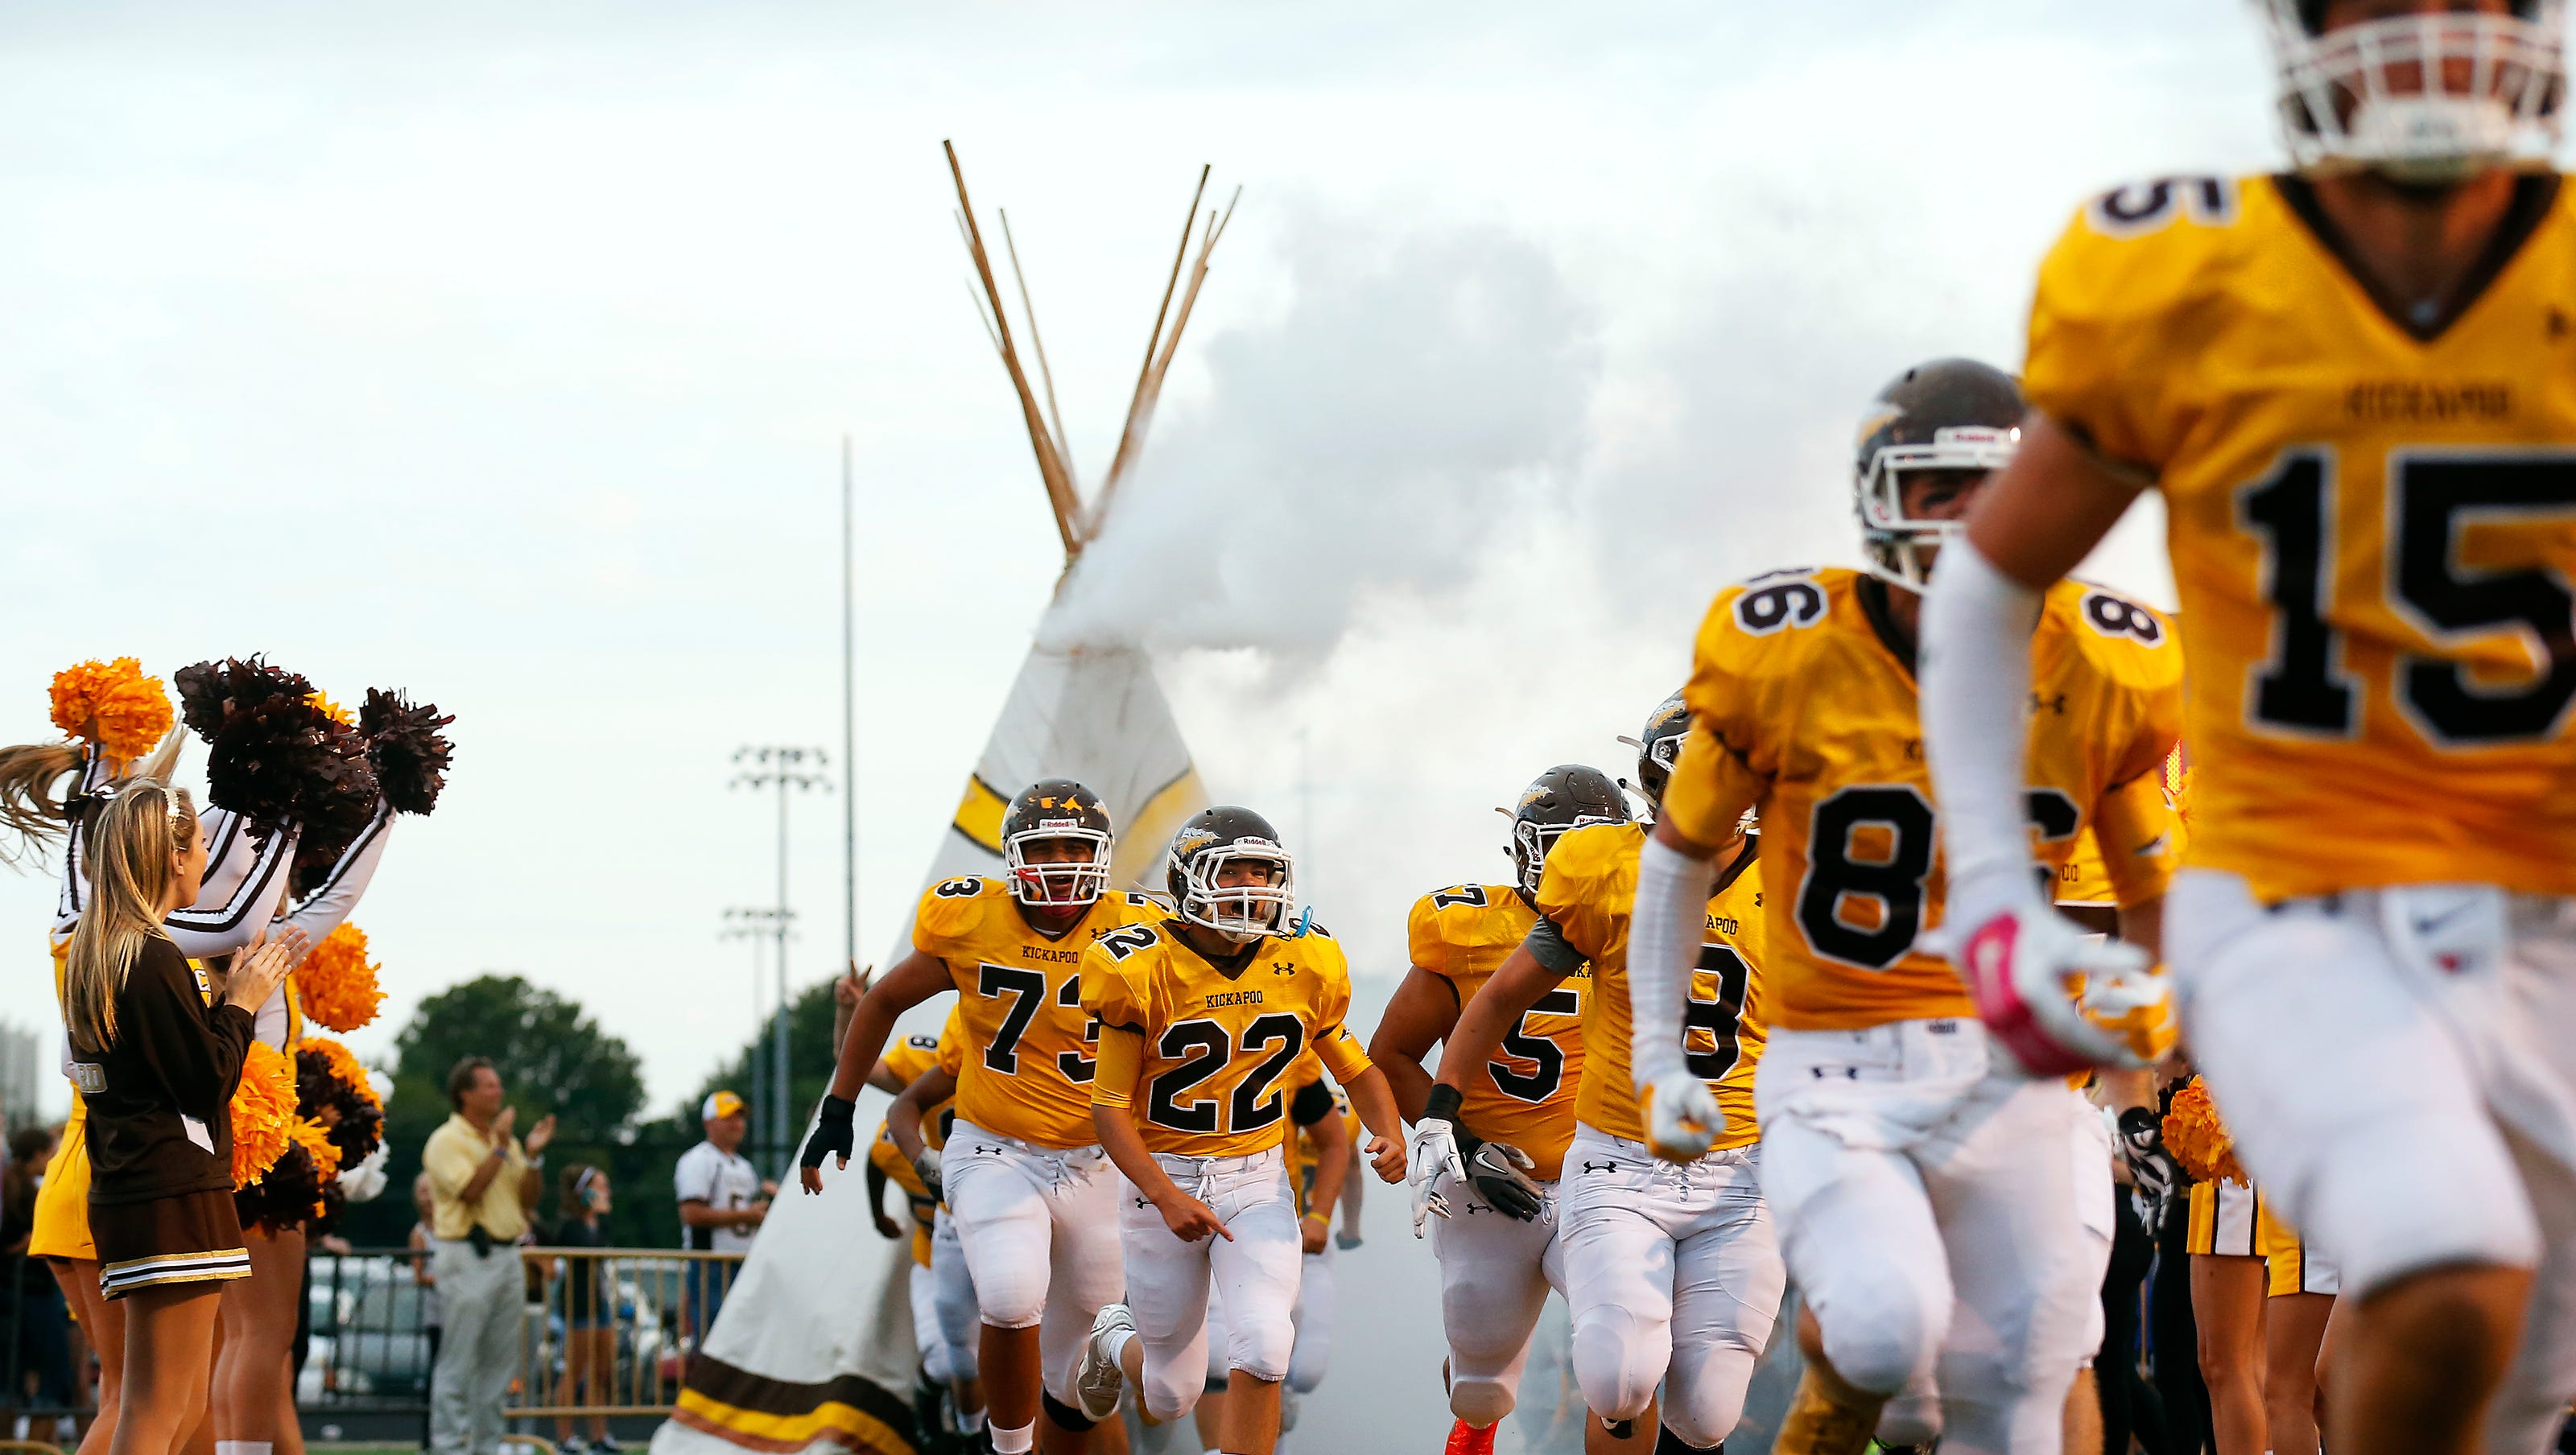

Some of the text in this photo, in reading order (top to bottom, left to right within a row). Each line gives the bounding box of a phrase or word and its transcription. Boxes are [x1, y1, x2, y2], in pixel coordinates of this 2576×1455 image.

[2087, 174, 2241, 240] 5
[1732, 571, 1830, 637] 6
[2079, 589, 2167, 649] 8
[2231, 443, 2576, 754] 15
[934, 875, 984, 900] 3
[1430, 884, 1488, 912] 7
[1100, 925, 1160, 962] 2
[1704, 915, 1738, 936] APOO
[1022, 946, 1079, 964] KICKAPOO
[1205, 991, 1263, 1008] KICKAPOO
[1488, 987, 1581, 1104] 5
[1147, 1012, 1304, 1134] 22
